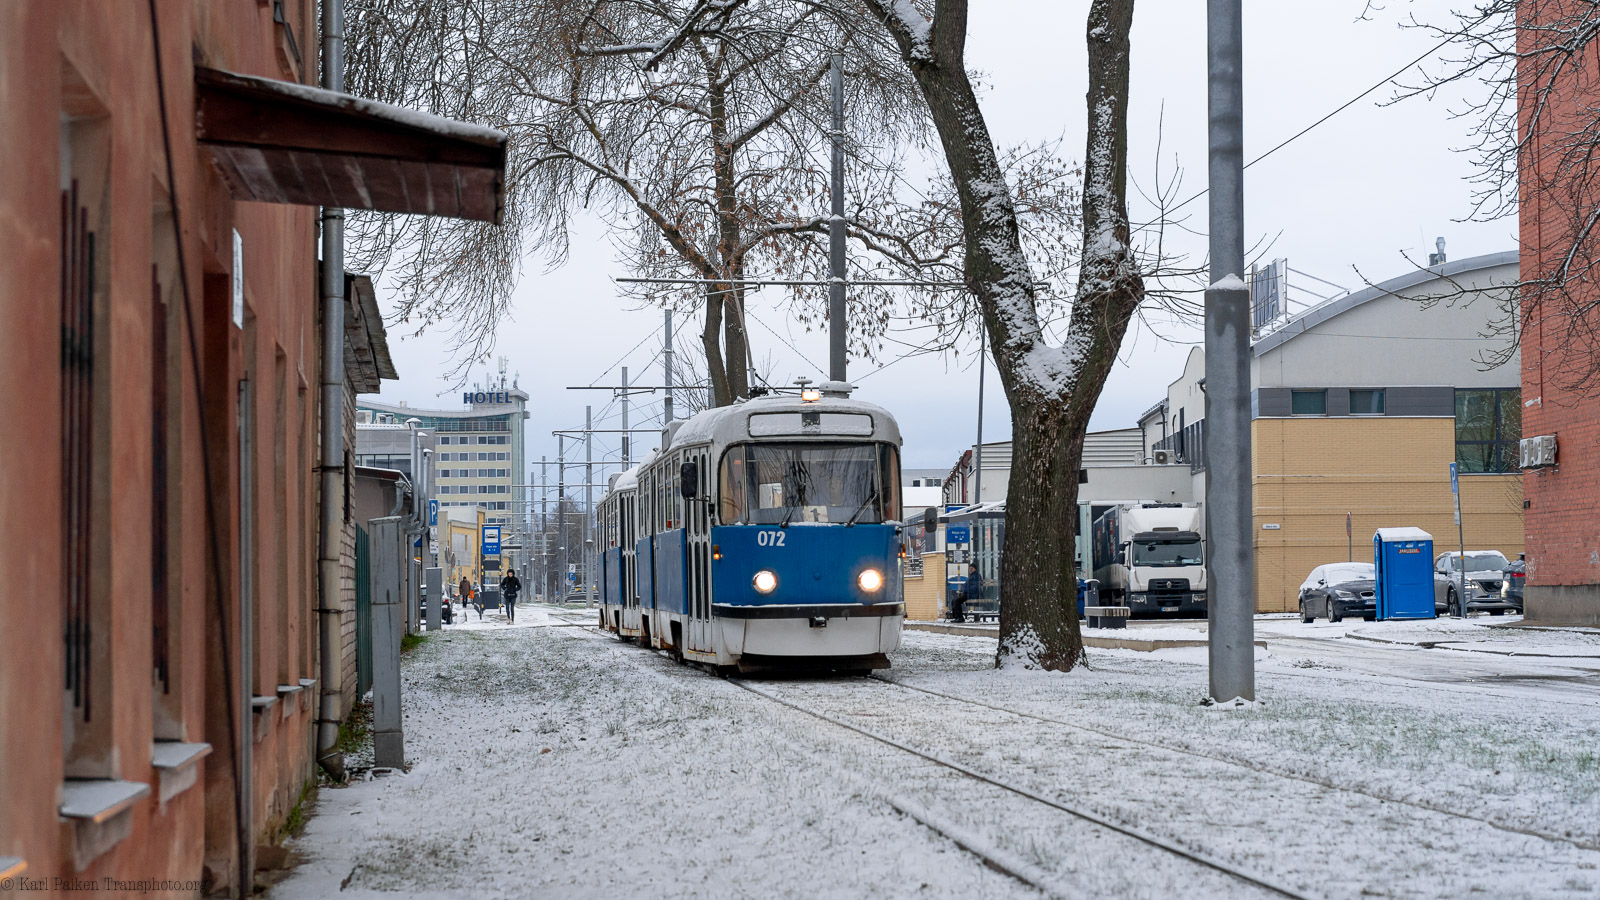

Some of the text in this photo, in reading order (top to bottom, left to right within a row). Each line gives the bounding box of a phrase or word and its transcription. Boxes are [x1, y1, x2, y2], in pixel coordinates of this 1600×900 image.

[463, 391, 513, 404] HOTEL
[431, 502, 437, 523] P
[757, 530, 786, 547] 072
